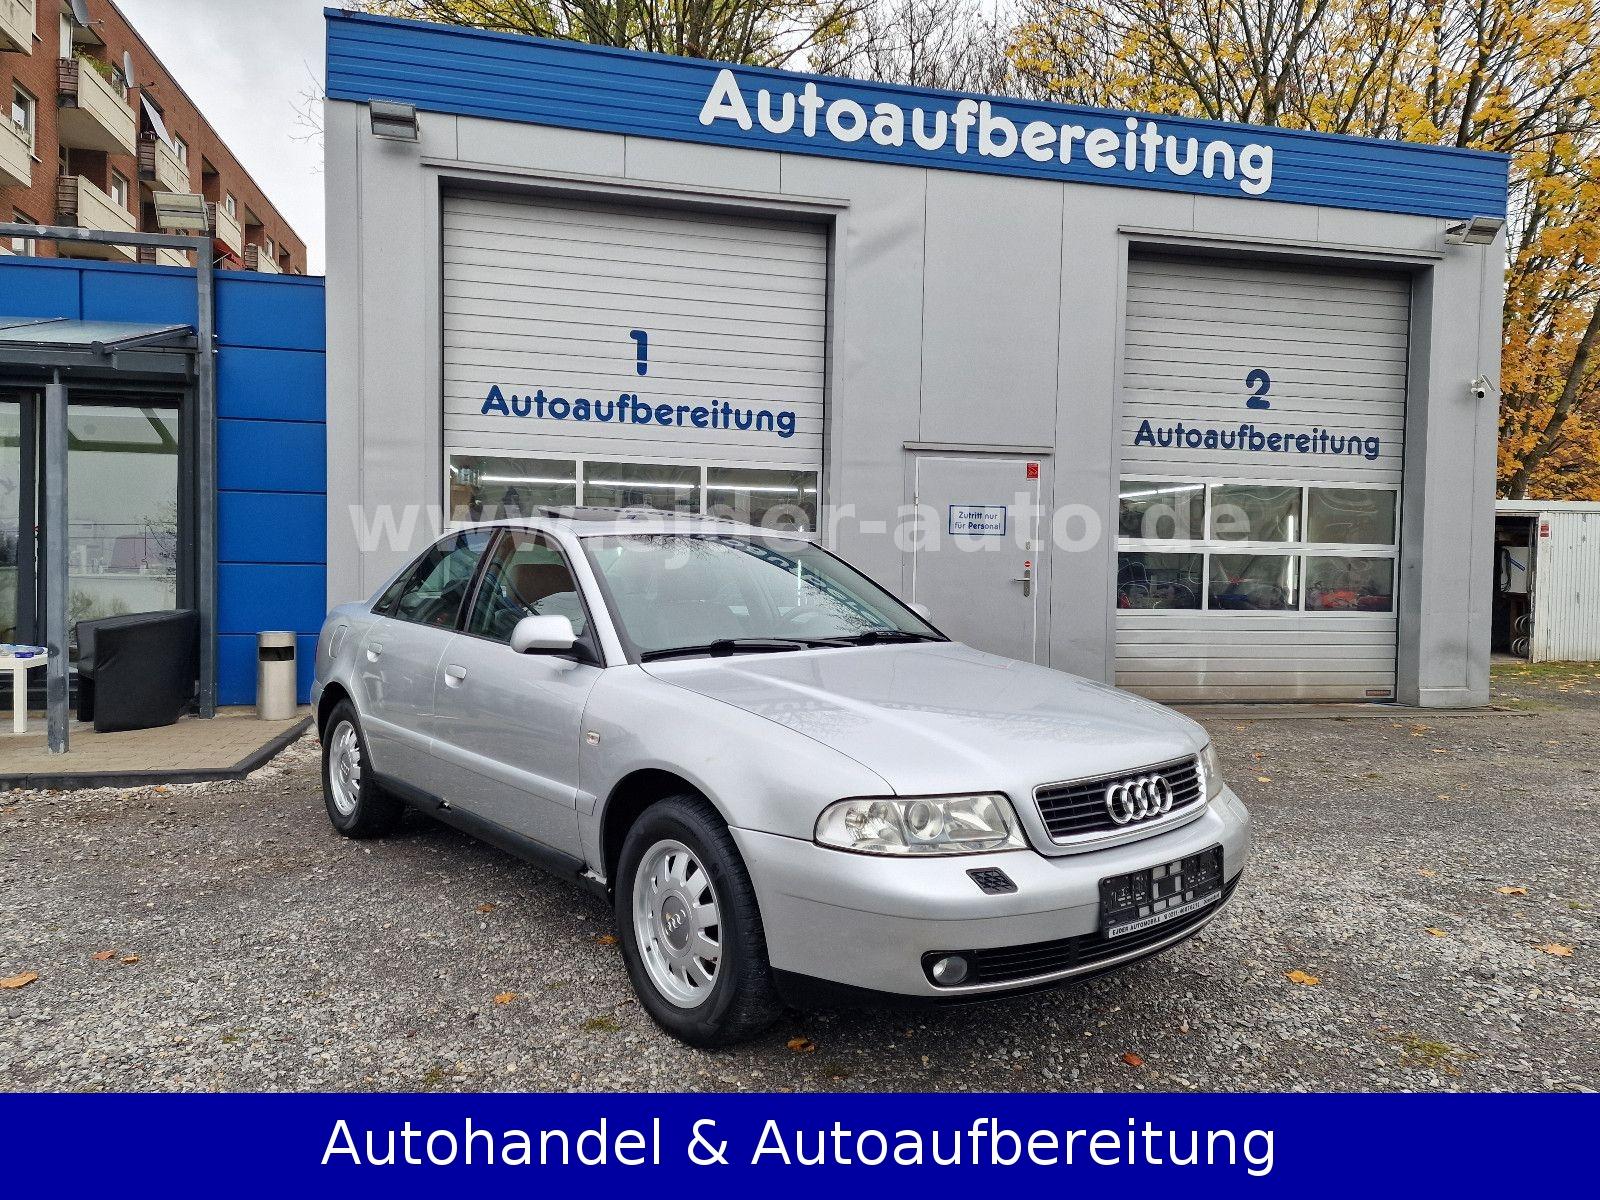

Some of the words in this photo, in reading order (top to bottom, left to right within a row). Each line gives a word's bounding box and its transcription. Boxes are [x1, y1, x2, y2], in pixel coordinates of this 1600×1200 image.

[699, 68, 1273, 195] Autoaufbereitung
[630, 330, 648, 375] 1
[1246, 368, 1271, 409] 2
[481, 384, 796, 438] Autoaufbereitung
[1134, 419, 1380, 461] Autoaufbereitung
[954, 521, 966, 530] für
[968, 521, 1001, 530] Personal
[958, 511, 983, 520] Zutritt
